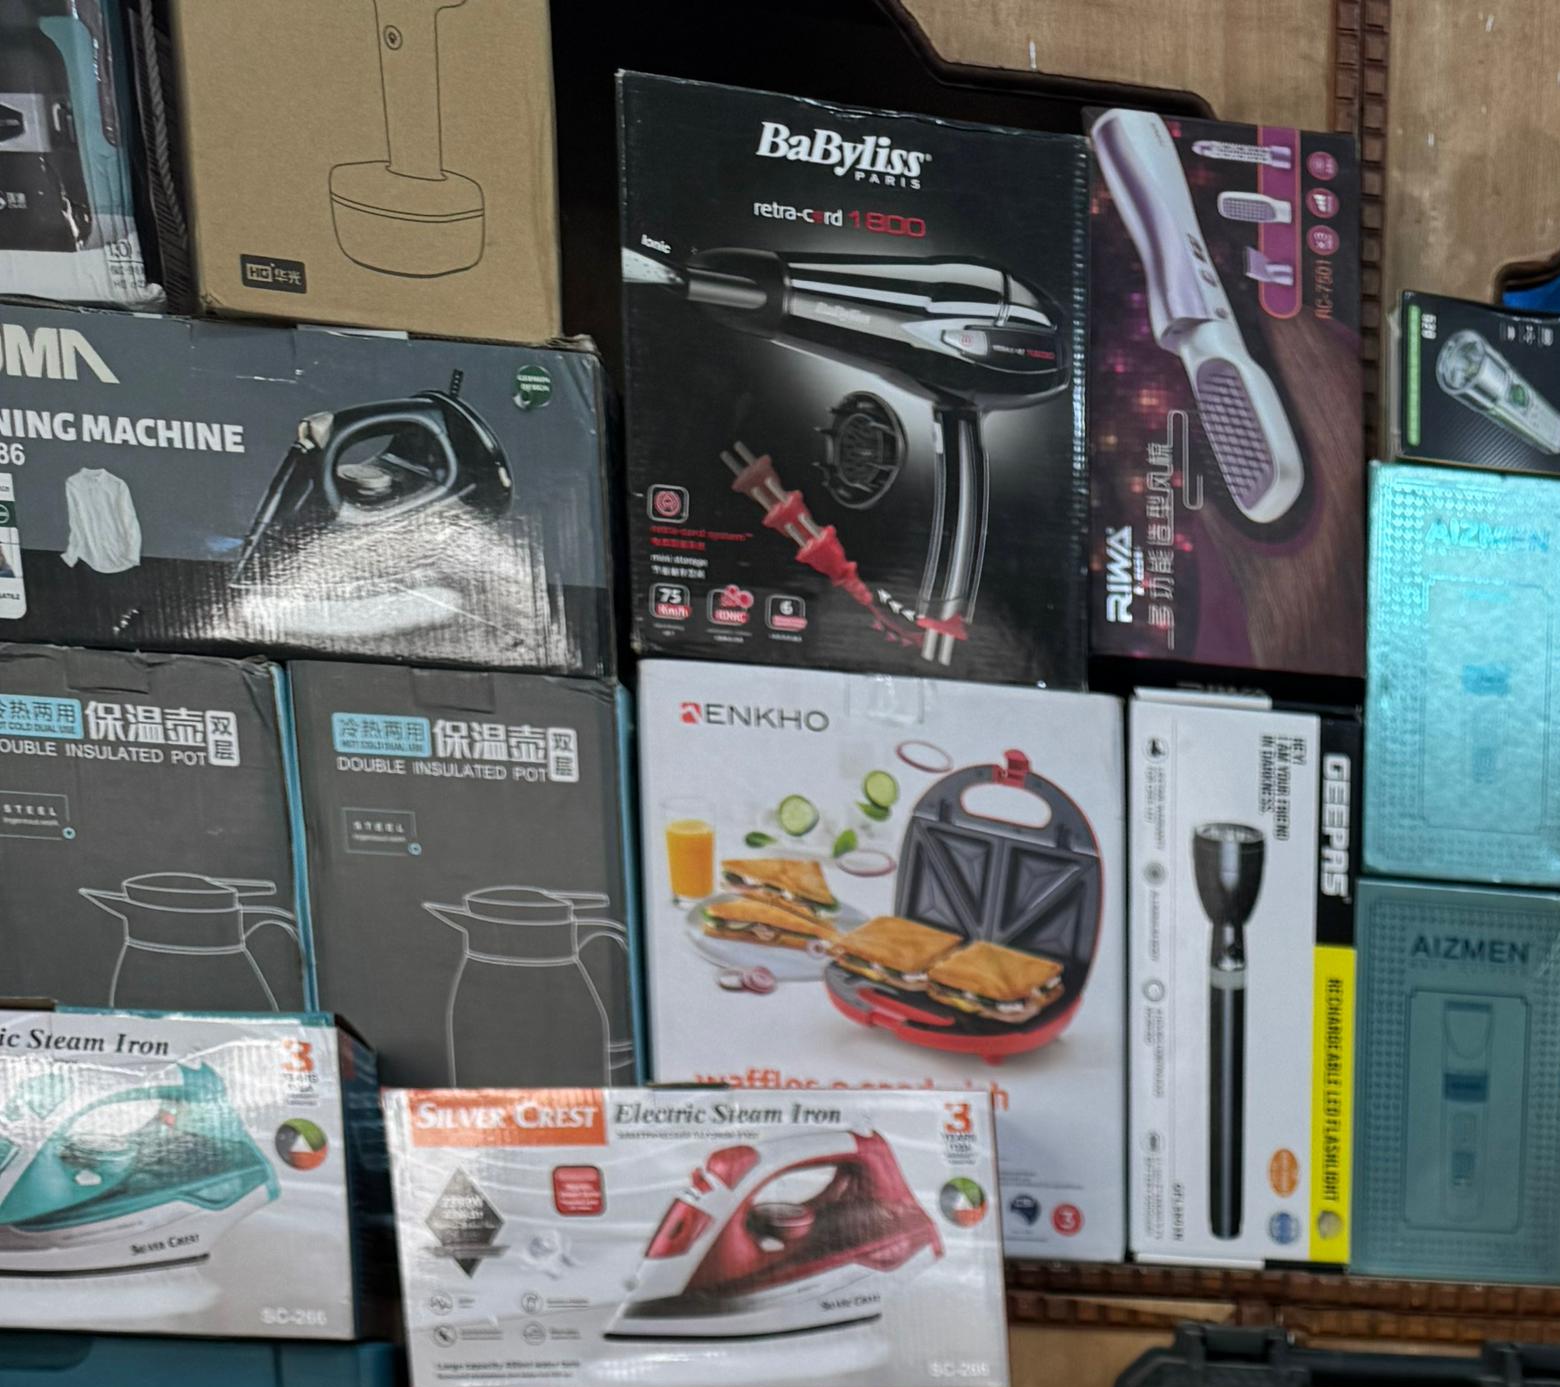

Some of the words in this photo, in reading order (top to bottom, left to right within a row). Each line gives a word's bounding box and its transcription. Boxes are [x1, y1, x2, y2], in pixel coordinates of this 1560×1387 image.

[756, 121, 925, 177] BaByliss
[854, 171, 922, 189] PARIS
[848, 209, 926, 238] 1800
[82, 415, 245, 453] MACHINE
[1106, 526, 1133, 625] RIWA
[658, 587, 683, 604] 75
[85, 701, 207, 747] 保温壶
[209, 715, 235, 762] 双层
[339, 718, 425, 743] 冷热两用
[65, 742, 164, 764] INSULATED
[170, 749, 207, 767] POT
[432, 718, 549, 764] 保温壶
[553, 731, 576, 778] 双层
[336, 755, 407, 775] DOUBLE
[412, 759, 508, 781] INSULATED
[511, 766, 549, 783] POT
[3, 804, 58, 817] STEEL
[1321, 753, 1351, 897] GEEPAS
[352, 820, 406, 834] STEEL
[1409, 936, 1530, 966] AIZMEN
[27, 1030, 106, 1053] Steam
[115, 1033, 170, 1057] Iron
[1324, 978, 1344, 1087] RECHARGEABLE
[280, 1039, 315, 1073] 3
[416, 1103, 506, 1131] SILVER
[513, 1102, 599, 1130] CREST
[614, 1103, 707, 1127] Electric
[709, 1104, 784, 1126] Steam
[790, 1104, 844, 1126] Iron
[1324, 1089, 1343, 1117] LED
[943, 1103, 973, 1134] 3
[1322, 1119, 1341, 1204] FLASHLIGHT
